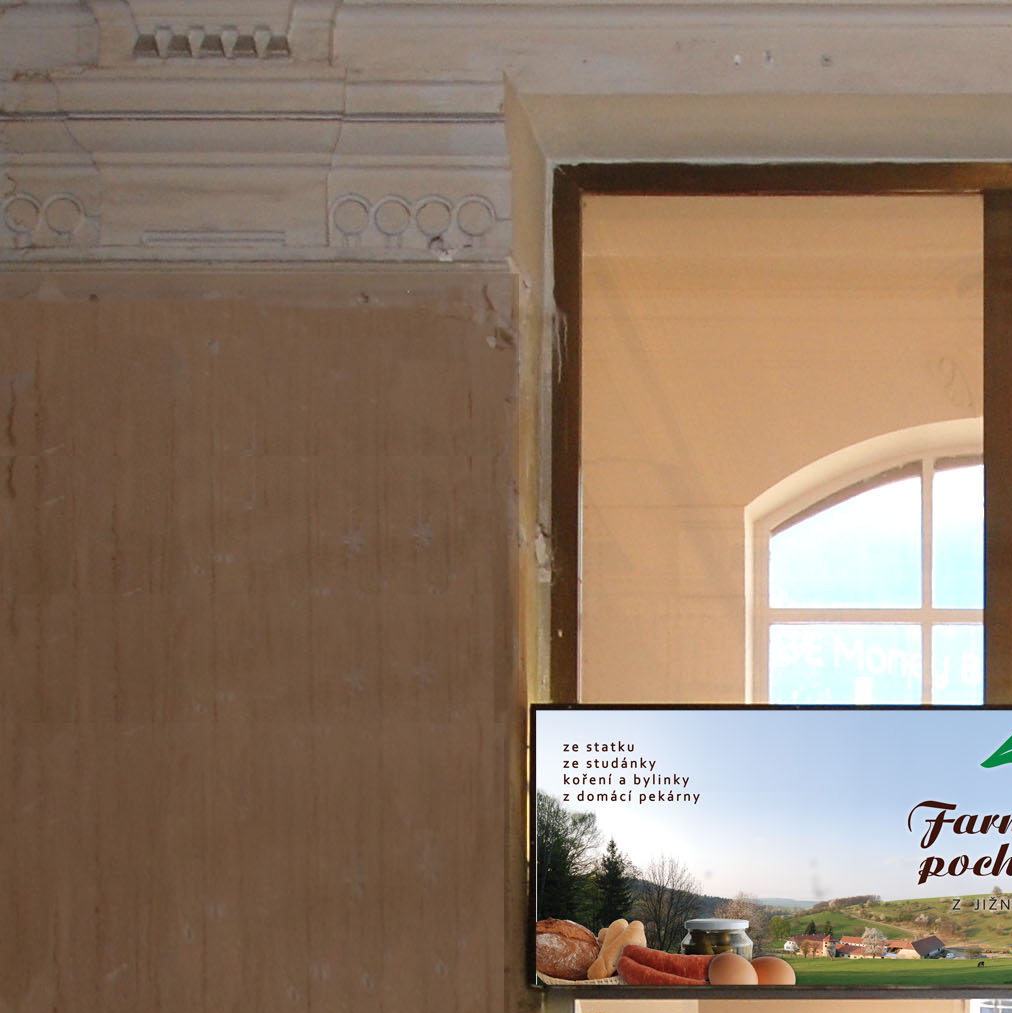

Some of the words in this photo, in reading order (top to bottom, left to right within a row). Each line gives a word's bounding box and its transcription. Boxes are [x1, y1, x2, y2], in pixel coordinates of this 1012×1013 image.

[563, 743, 578, 751] ze
[586, 740, 635, 752] statku
[563, 760, 578, 768] ze
[586, 757, 656, 771] studánky
[563, 773, 612, 785] koření
[619, 776, 626, 785] a
[633, 773, 689, 787] bylinky
[563, 793, 569, 801] z
[577, 789, 631, 801] domácí
[639, 789, 700, 804] pekárny
[952, 898, 961, 911] Z
